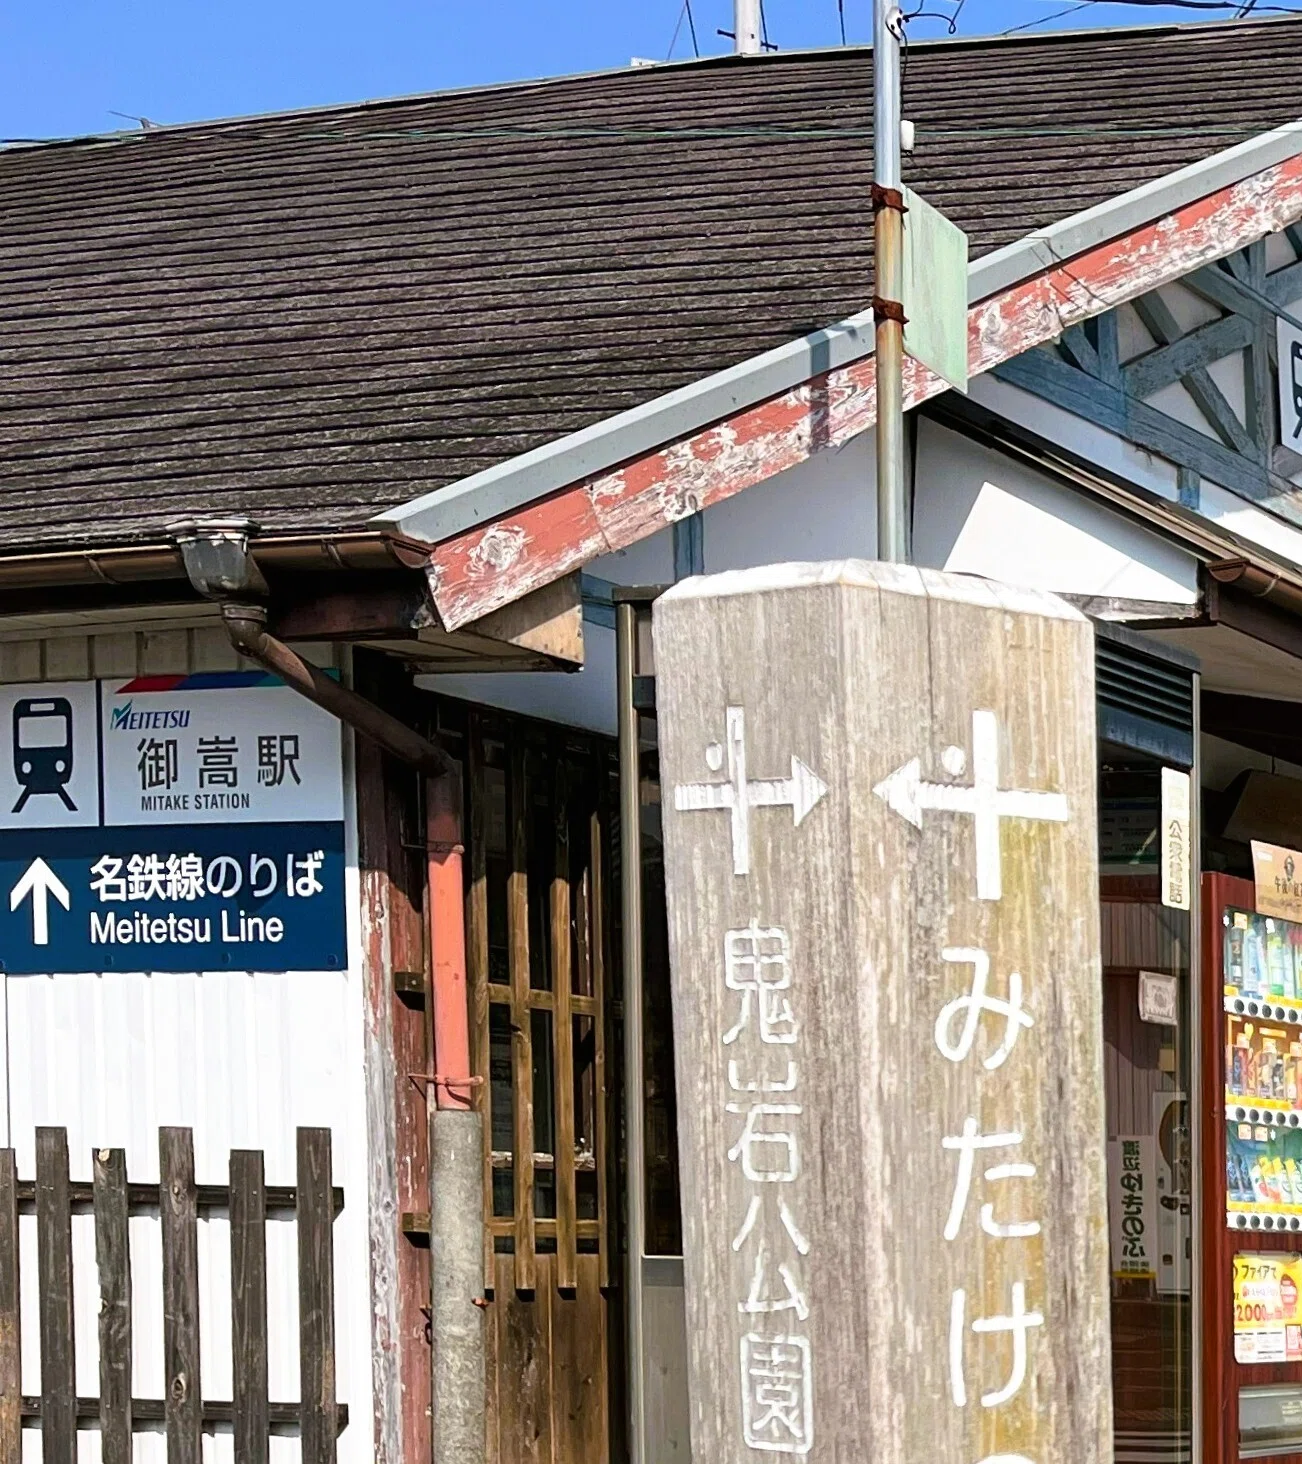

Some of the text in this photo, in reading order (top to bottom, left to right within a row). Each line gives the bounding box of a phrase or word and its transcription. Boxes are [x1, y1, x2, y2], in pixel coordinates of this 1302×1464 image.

[110, 699, 191, 731] MEITETSU
[136, 734, 302, 789] 御嵩駅
[140, 792, 250, 812] MITAKE STATION
[89, 849, 325, 903] 名鉄線のりば
[89, 908, 285, 945] Meitetsu Line
